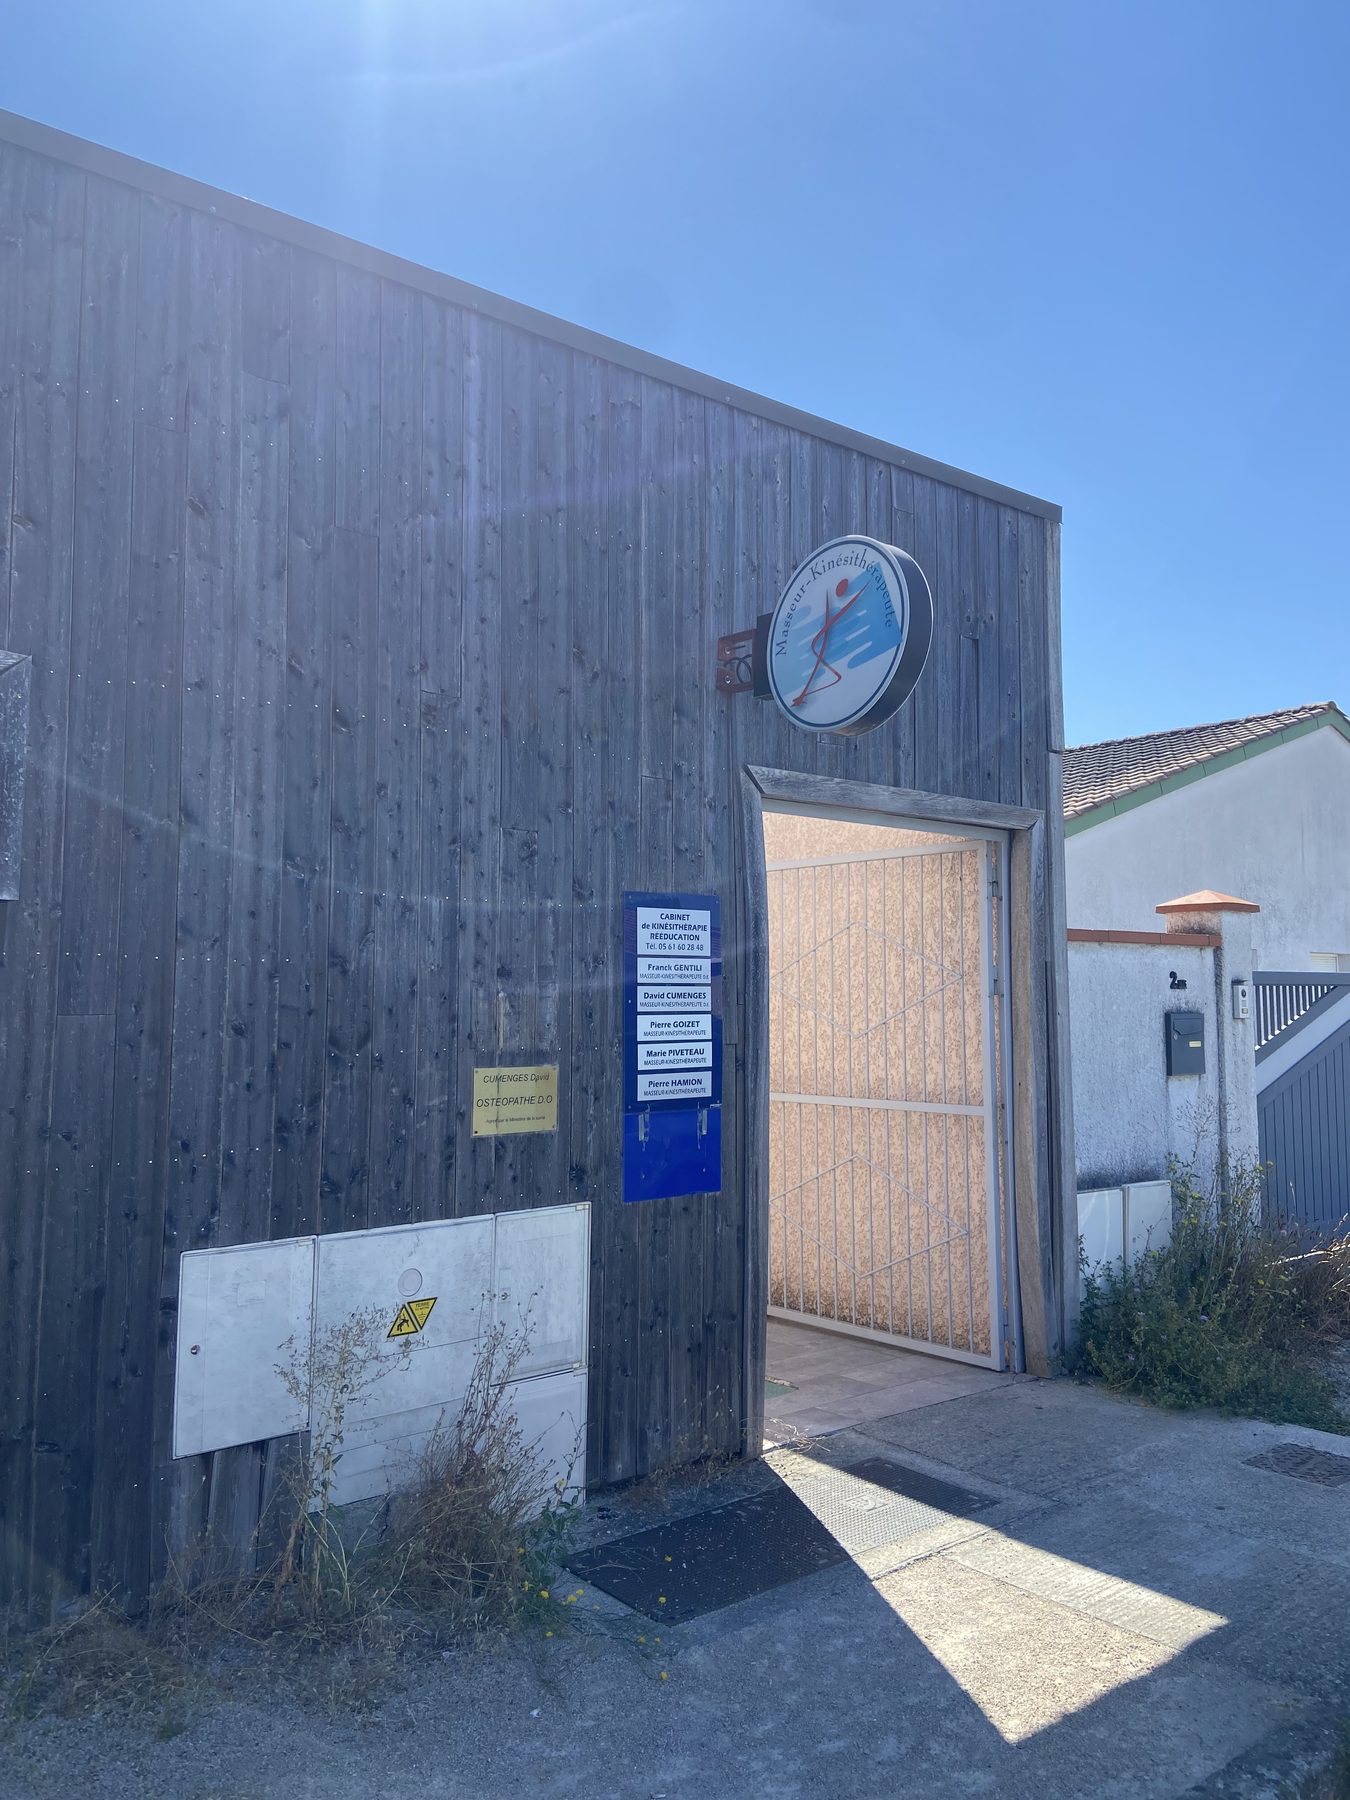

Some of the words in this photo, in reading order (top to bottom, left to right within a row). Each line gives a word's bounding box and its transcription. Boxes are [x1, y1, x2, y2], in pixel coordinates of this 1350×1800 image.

[775, 548, 896, 657] Masseur-Kinésithérapeute
[660, 913, 690, 921] CABINET
[651, 922, 708, 932] KINÉSITHÉRAPIE
[650, 931, 700, 941] RÉÉDUCATION
[668, 943, 676, 951] 61
[677, 943, 686, 951] 60
[648, 963, 672, 971] Franck
[673, 964, 702, 972] GENTILI
[650, 1021, 672, 1029] Pierre
[672, 1020, 700, 1028] GOIZET
[646, 1049, 667, 1057] Marie
[668, 1048, 705, 1057] PIVETEAU
[483, 1073, 529, 1083] CUMENGES
[530, 1073, 550, 1083] David
[648, 1080, 670, 1088] Pierre
[670, 1078, 703, 1087] HAMION
